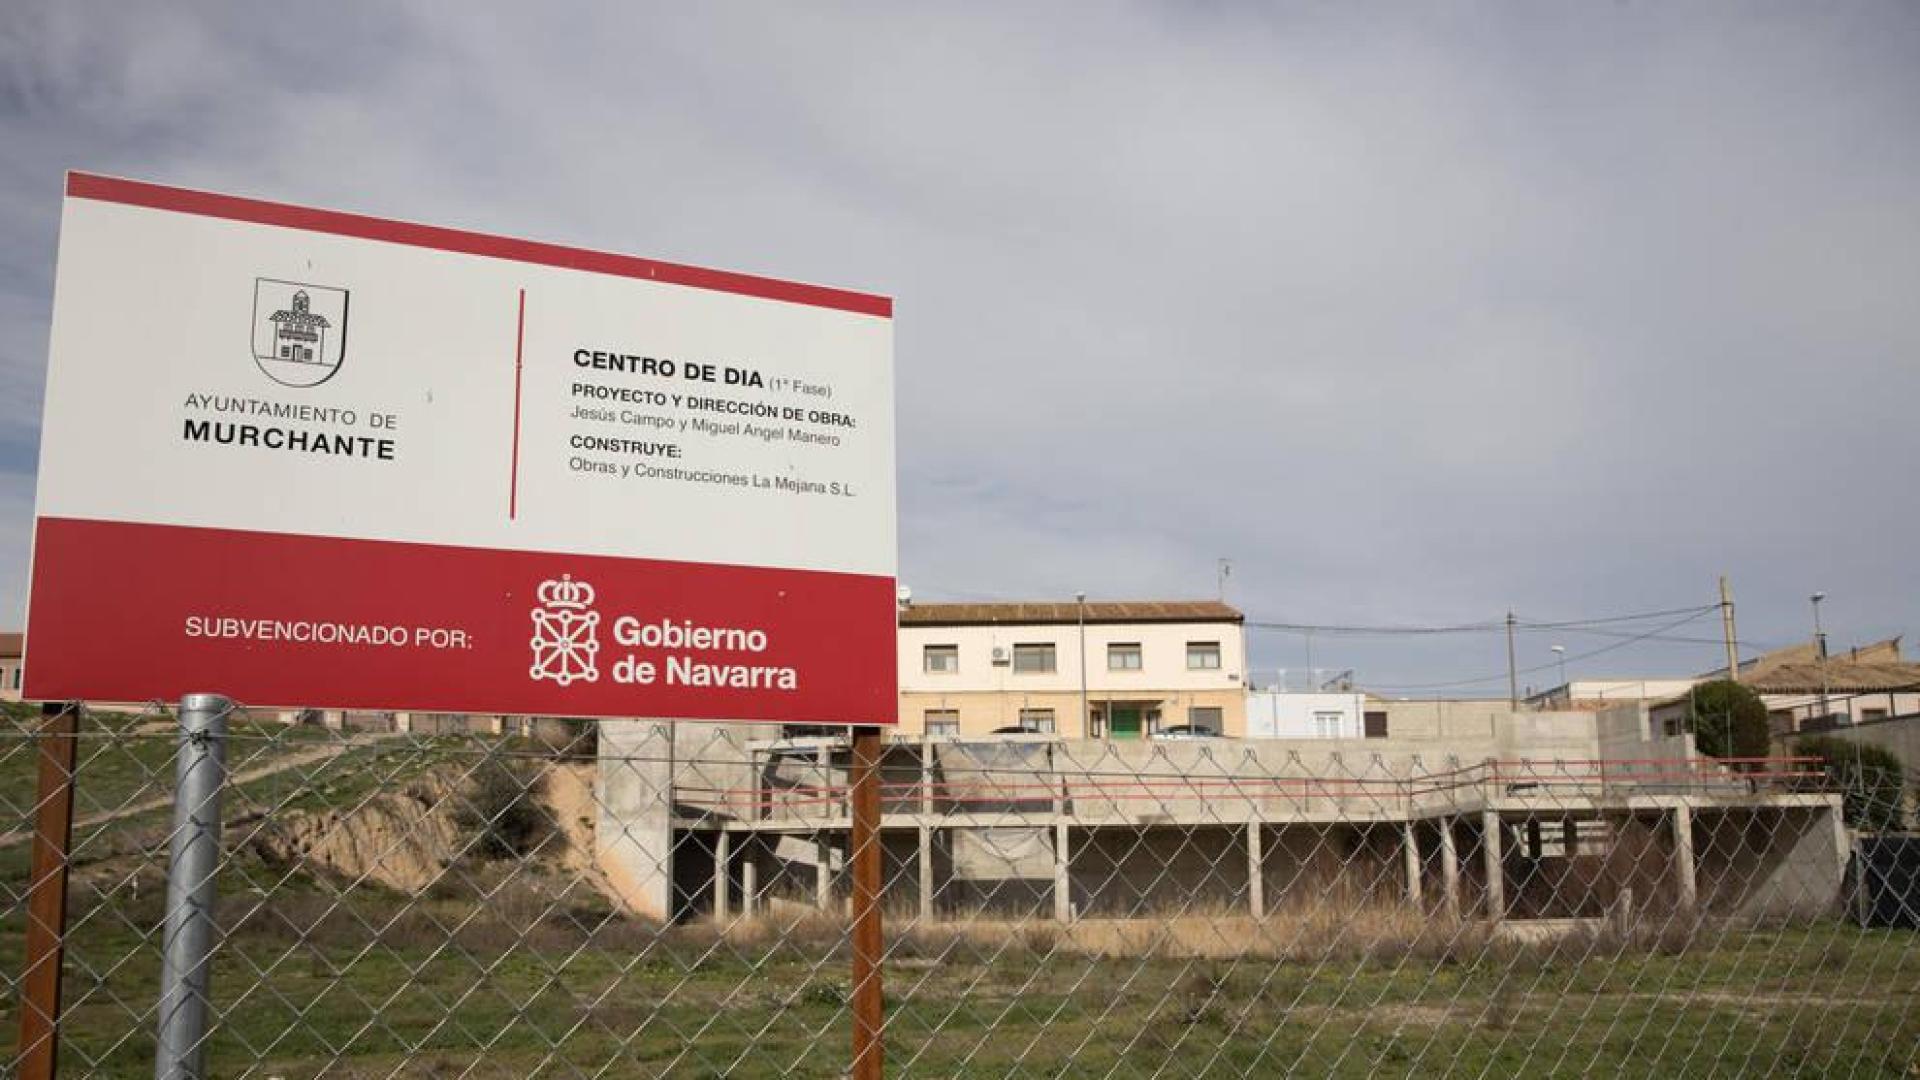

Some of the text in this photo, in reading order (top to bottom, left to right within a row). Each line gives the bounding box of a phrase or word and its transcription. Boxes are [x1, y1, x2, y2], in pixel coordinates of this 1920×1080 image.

[573, 349, 675, 377] CENTRO
[684, 362, 716, 382] DE
[725, 367, 763, 388] DIA
[792, 379, 832, 399] Fase)
[184, 393, 397, 430] AYUNTAMIENTO DE
[571, 383, 856, 429] PROYECTO Y DIRECCIÓN DE OBRA:
[183, 418, 395, 460] MURCHANTE
[570, 405, 841, 447] Jesús Campo y Miguel Angel Manero
[569, 434, 682, 458] CONSTRUYE:
[569, 457, 856, 497] Obras y Construcciones La Mejana S.L.
[185, 616, 473, 650] SUBVENCIONADO POR:
[612, 615, 768, 652] Gobierno
[612, 654, 798, 691] de Navarra
